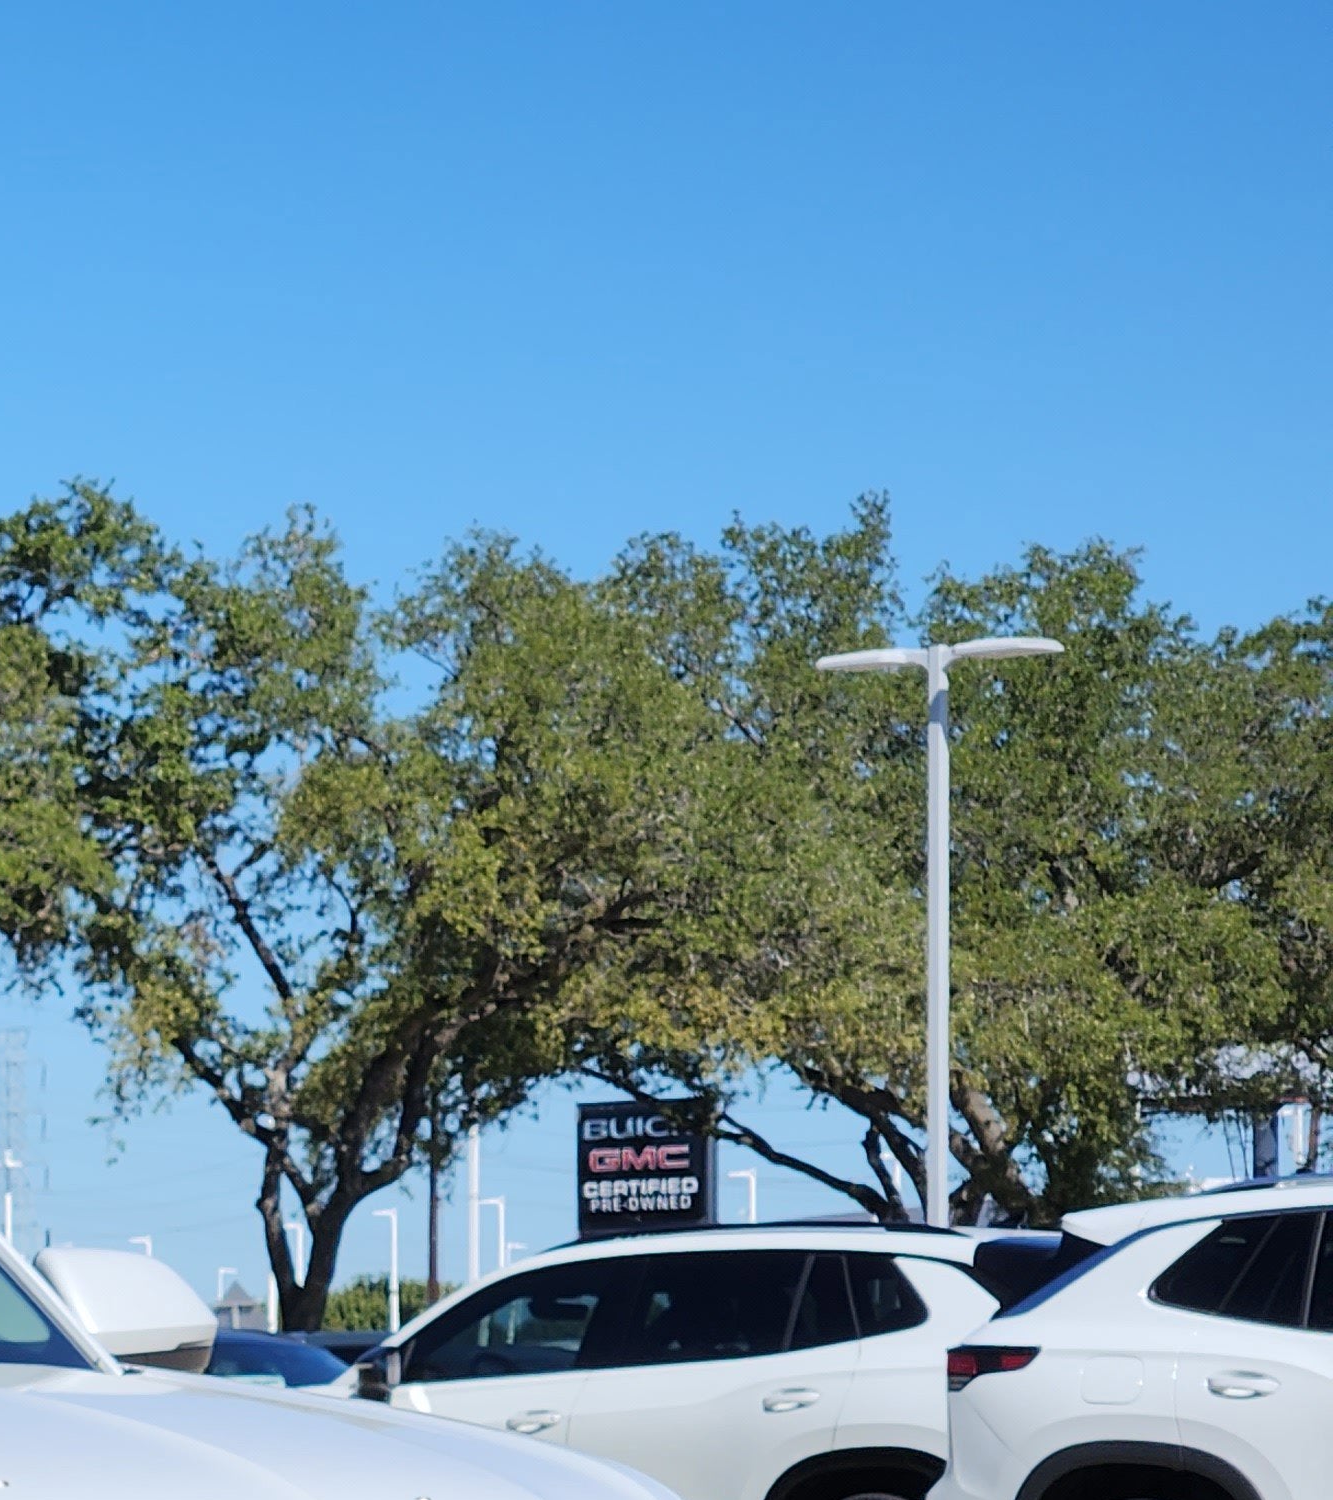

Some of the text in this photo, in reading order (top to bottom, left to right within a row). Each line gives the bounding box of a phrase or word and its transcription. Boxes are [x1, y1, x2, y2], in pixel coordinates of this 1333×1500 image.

[583, 1115, 695, 1141] BUIC
[588, 1144, 690, 1173] GMC
[583, 1176, 699, 1199] CERTIFIED
